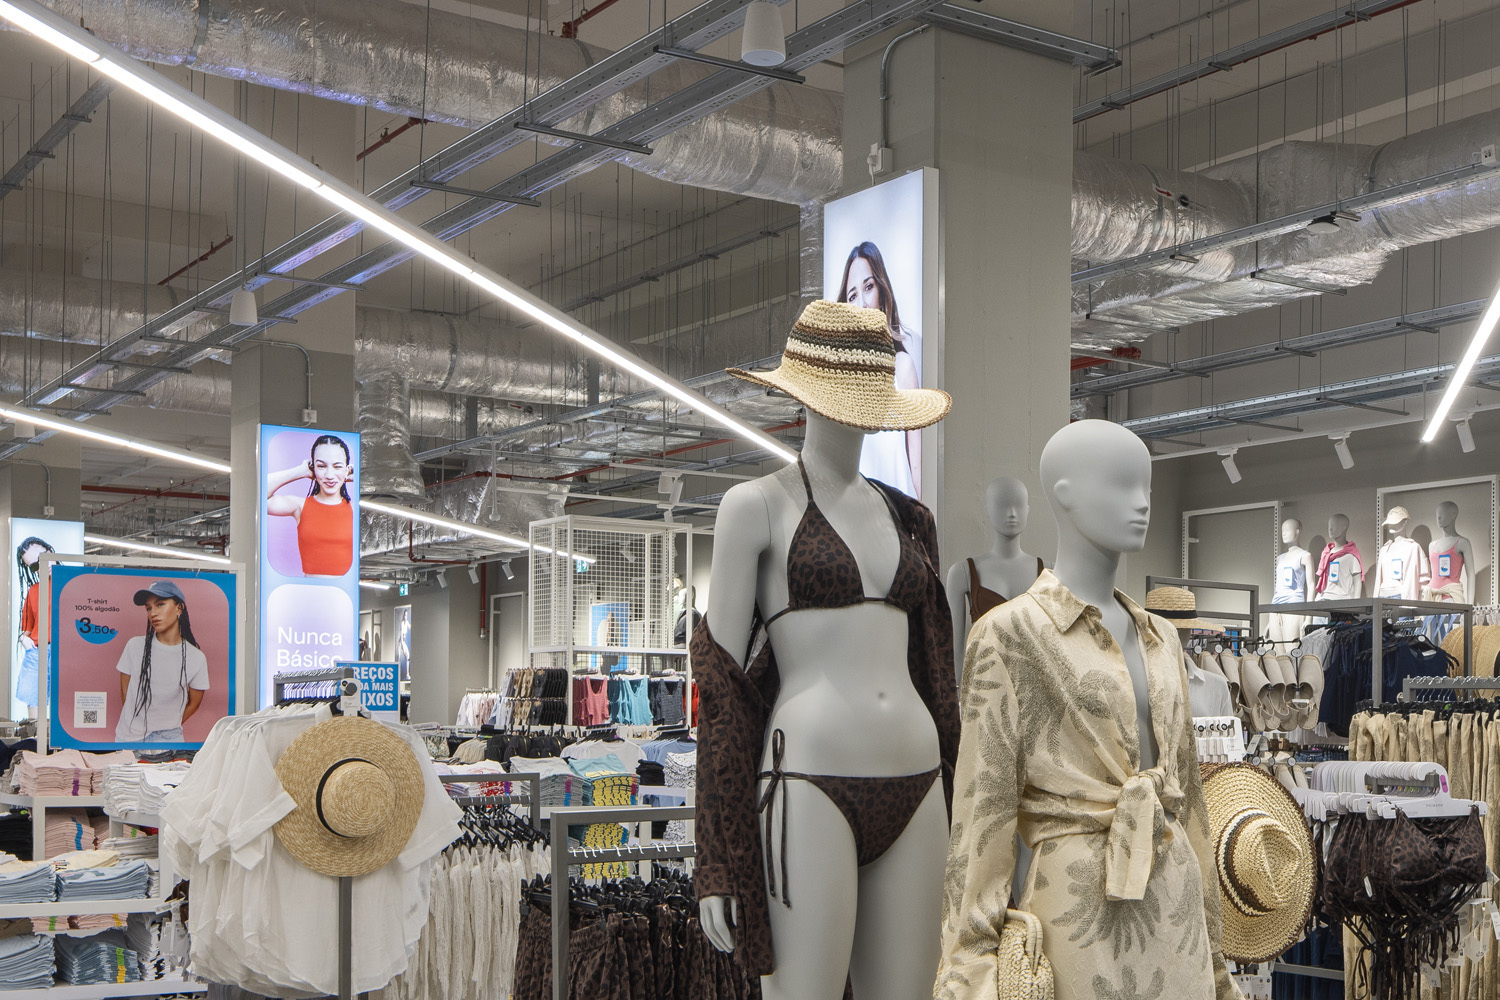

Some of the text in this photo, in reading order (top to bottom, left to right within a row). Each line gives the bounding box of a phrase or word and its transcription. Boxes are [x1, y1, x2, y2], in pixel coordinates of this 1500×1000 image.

[277, 626, 343, 646] Nunca
[352, 667, 394, 682] REÇOS
[372, 682, 394, 691] MAIS
[362, 692, 394, 706] IXOS
